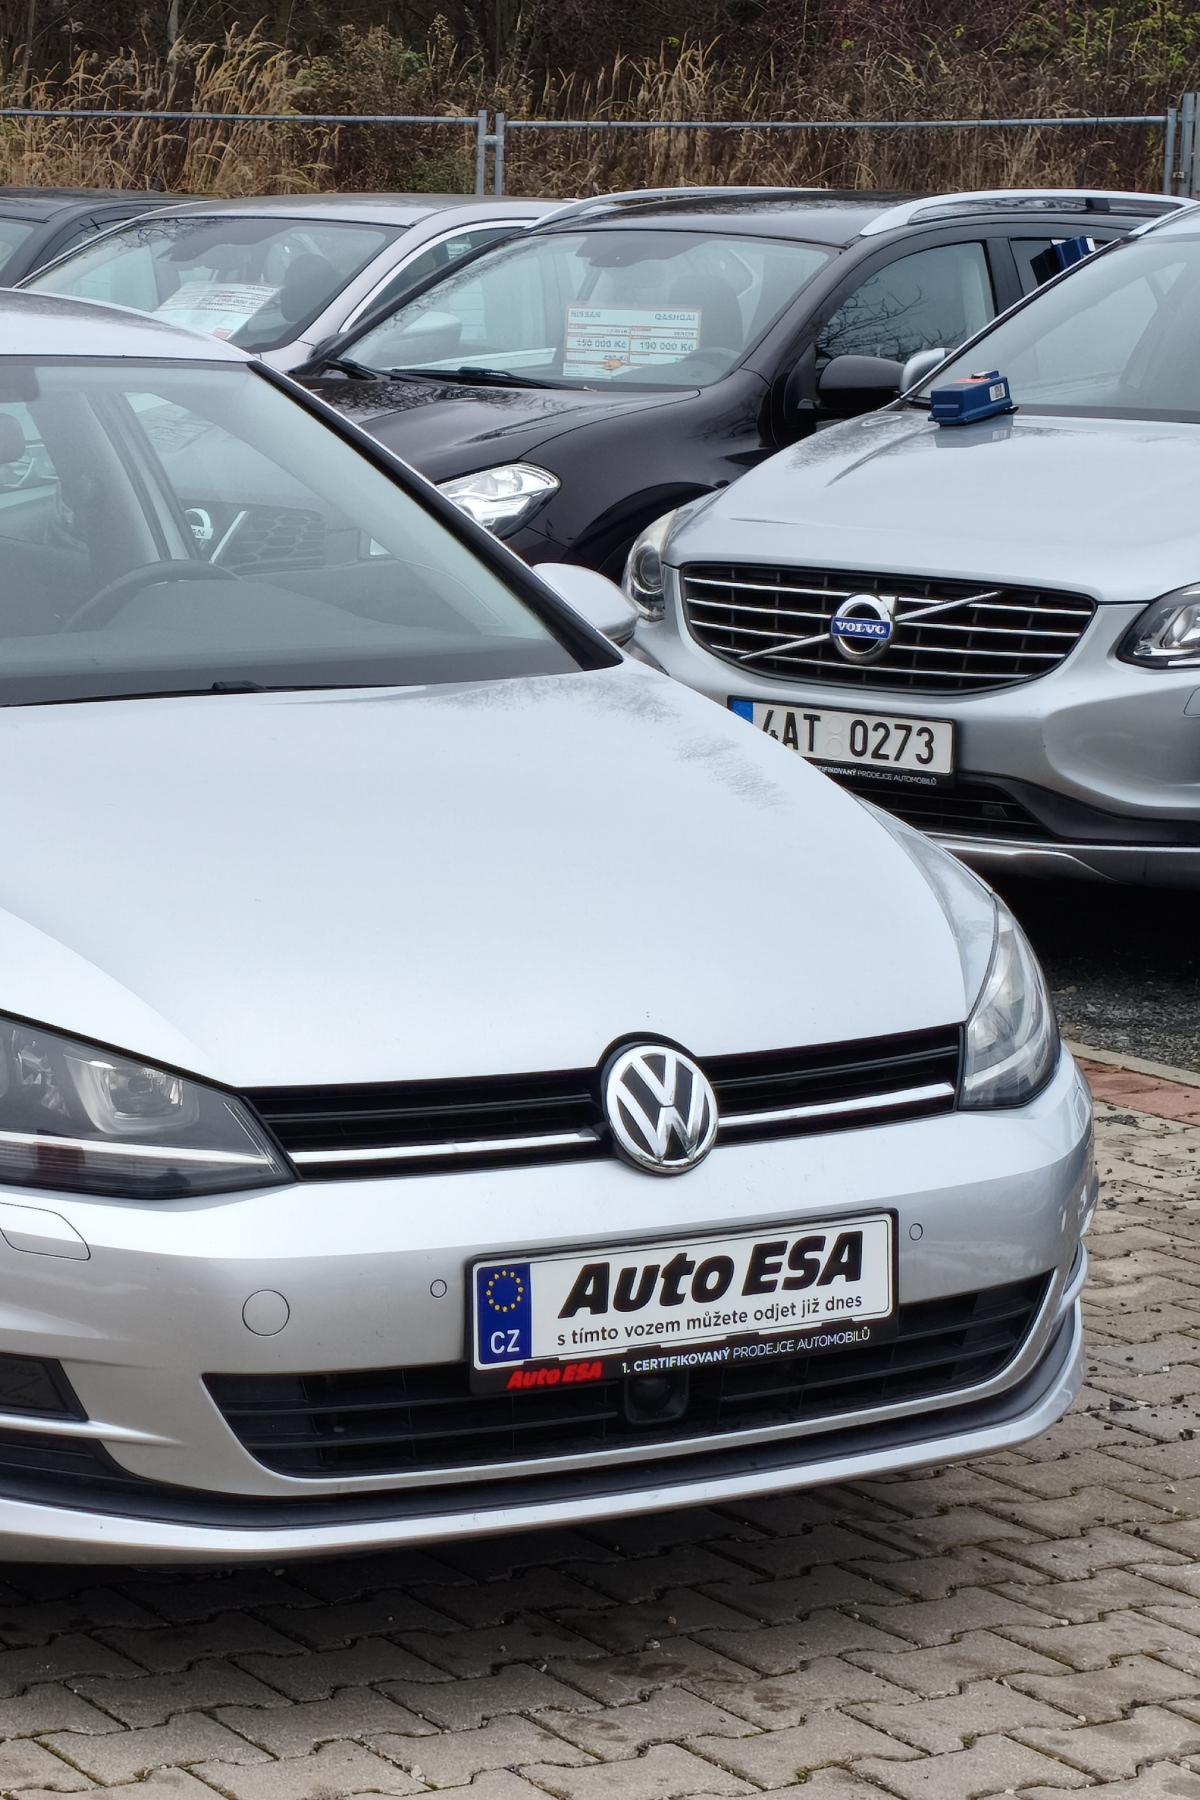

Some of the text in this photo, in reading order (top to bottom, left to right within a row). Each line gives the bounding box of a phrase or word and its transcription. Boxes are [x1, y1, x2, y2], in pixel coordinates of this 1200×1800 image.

[835, 621, 887, 633] VOLVO
[850, 719, 934, 764] 0273
[558, 1231, 863, 1319] Auto ESA
[490, 1329, 520, 1354] CZ
[558, 1294, 863, 1346] s tímto vozem můžete odjet již dnes
[622, 1326, 870, 1373] 1. CERTIFIKOVANÝ PRODEJCE AUTOMOBILŮ
[506, 1361, 602, 1391] Auto ESA
